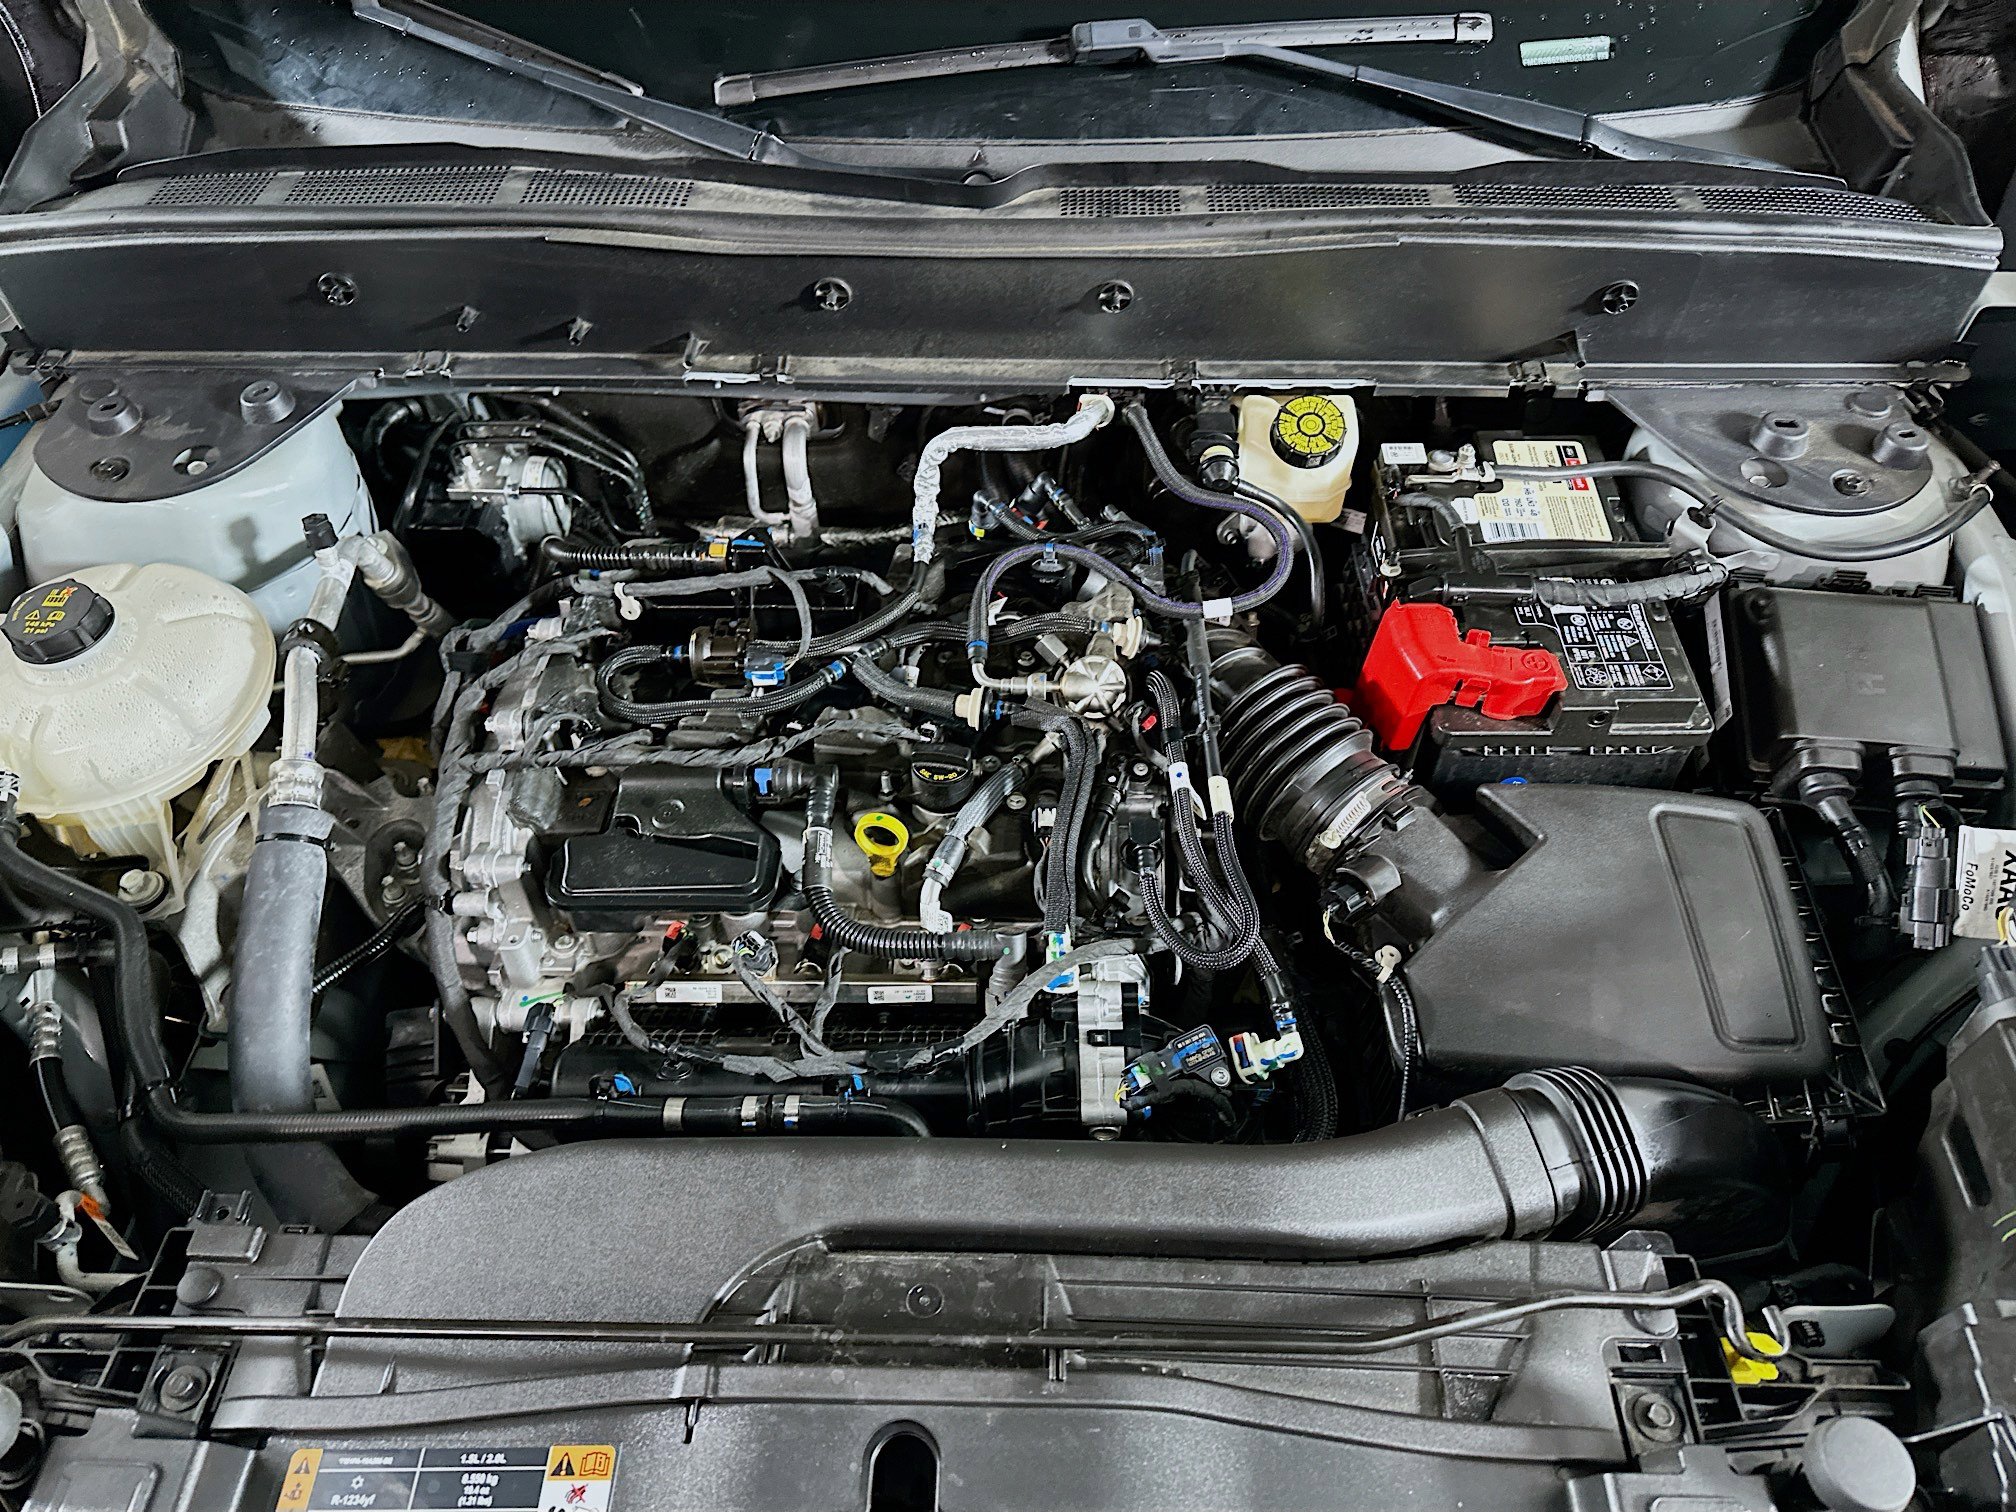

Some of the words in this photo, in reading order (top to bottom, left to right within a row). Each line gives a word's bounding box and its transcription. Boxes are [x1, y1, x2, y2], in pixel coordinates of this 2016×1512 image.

[1631, 603, 1655, 651] GER/POISON
[920, 768, 932, 778] SAE
[1962, 862, 1979, 911] FoMoCo
